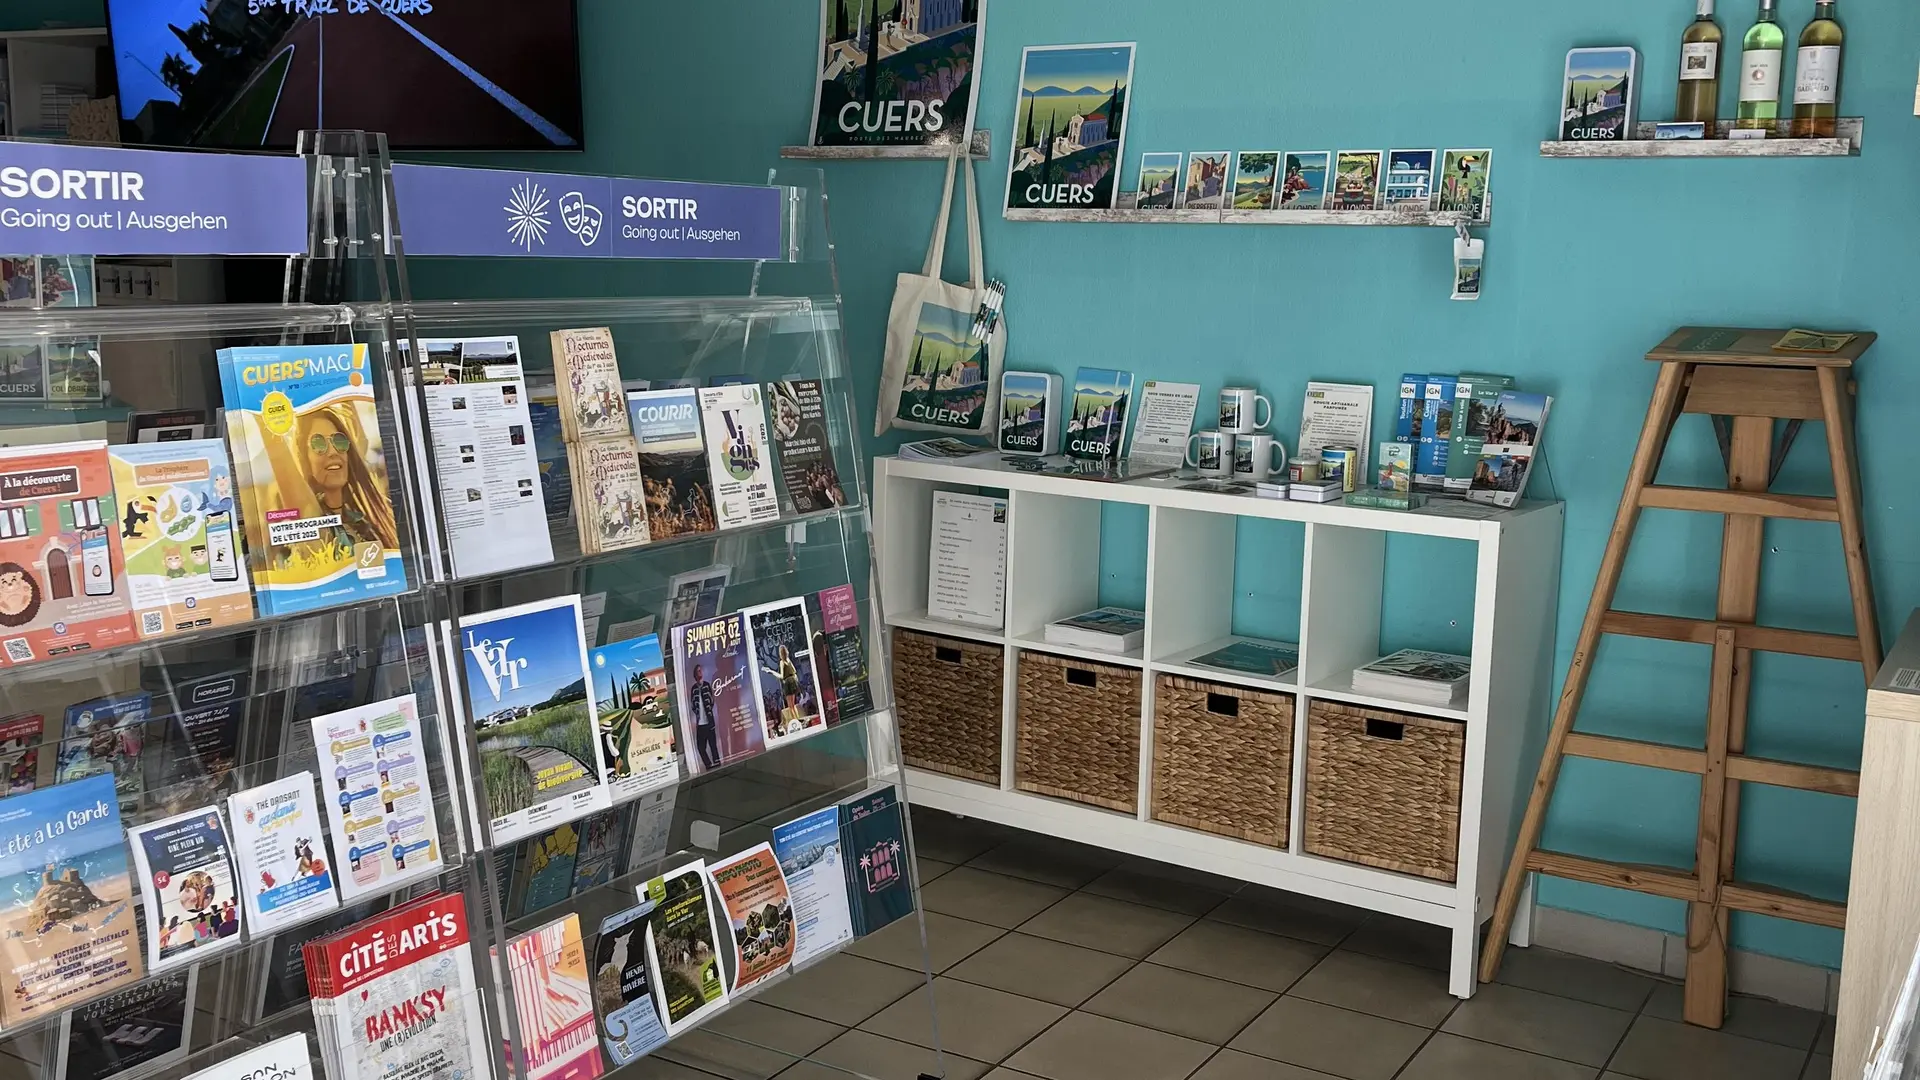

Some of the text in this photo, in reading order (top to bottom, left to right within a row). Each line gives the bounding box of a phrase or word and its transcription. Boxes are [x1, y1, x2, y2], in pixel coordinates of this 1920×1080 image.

[838, 99, 944, 133] CUERS
[1570, 127, 1616, 140] CUERS
[0, 166, 145, 201] SORTIR
[1025, 183, 1095, 204] CUERS
[622, 195, 698, 220] SORTIR
[1454, 202, 1480, 213] LONDE
[0, 207, 228, 232] Going out Ausgehen
[622, 224, 741, 242] Going out Ausgehen
[566, 337, 610, 354] Nocturnes
[0, 383, 36, 394] CUERS
[1401, 386, 1415, 395] IGN
[1426, 387, 1440, 395] IGN
[1456, 386, 1471, 395] IGN
[267, 404, 286, 414] GUIDE
[638, 403, 693, 423] COURIR
[911, 402, 970, 425] CUERS
[1006, 434, 1038, 446] CUERS
[1070, 439, 1111, 455] CUERS
[589, 448, 634, 465] Nocturnes
[3, 473, 72, 488] À la découverte
[19, 485, 57, 497] de Cuers
[267, 509, 299, 521] Découvrez
[271, 517, 339, 533] VOTRE PROGRAMME
[273, 529, 318, 543] DE L'ÉTÉ 2025
[686, 620, 741, 644] SUMMER 02
[765, 622, 794, 639] CŒUR
[687, 633, 727, 659] PARTY
[184, 710, 213, 722] OUVERT
[255, 789, 301, 812] THÉ DANSANT
[34, 827, 45, 844] à
[45, 821, 65, 840] La
[66, 799, 110, 831] Garde
[53, 942, 91, 960] NOCTURNES
[92, 928, 130, 947] MÉDIÉVALES
[386, 932, 399, 960] DES
[625, 963, 645, 981] HENRI
[622, 977, 646, 994] RIVIÈRE
[83, 981, 179, 1022] VOUS INSPIRER
[365, 985, 447, 1044] BANKSY
[379, 1037, 394, 1053] UNE
